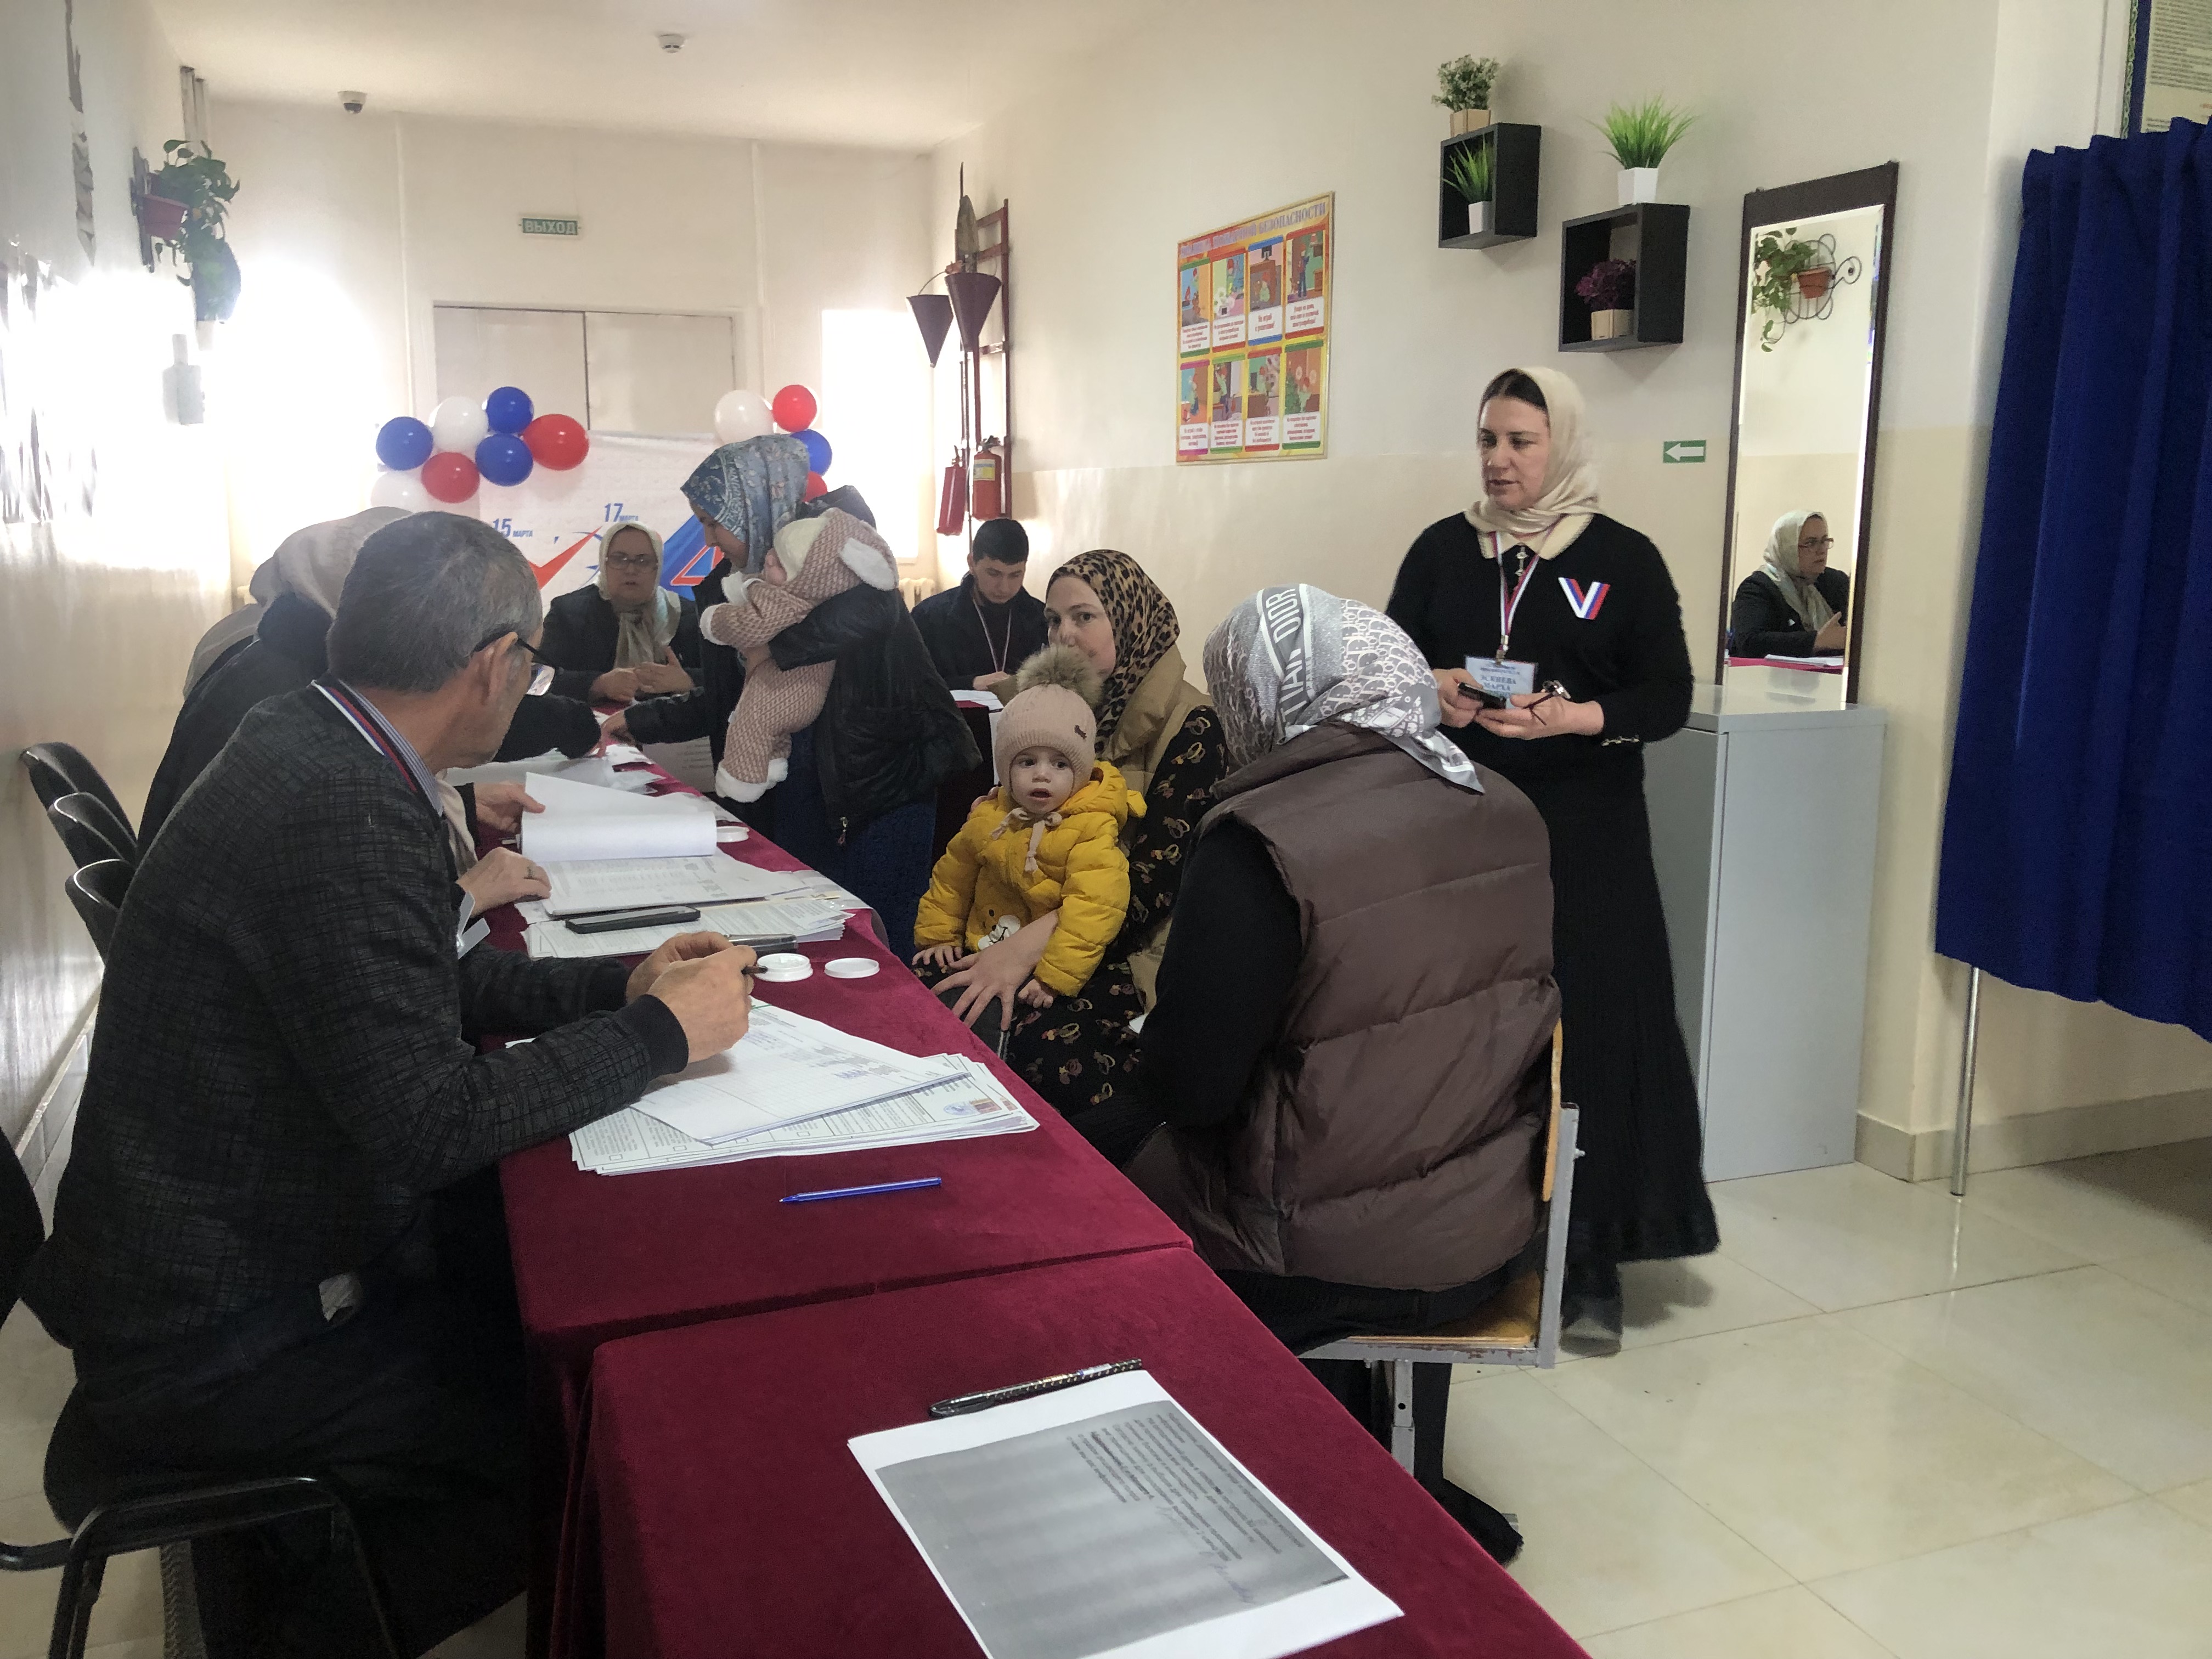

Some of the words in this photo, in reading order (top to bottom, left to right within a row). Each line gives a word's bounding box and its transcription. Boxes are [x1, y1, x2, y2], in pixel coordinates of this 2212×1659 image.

[525, 221, 576, 234] ВЫХОД
[605, 503, 623, 522] 17
[493, 518, 512, 538] 15
[1266, 589, 1301, 644] DIOR
